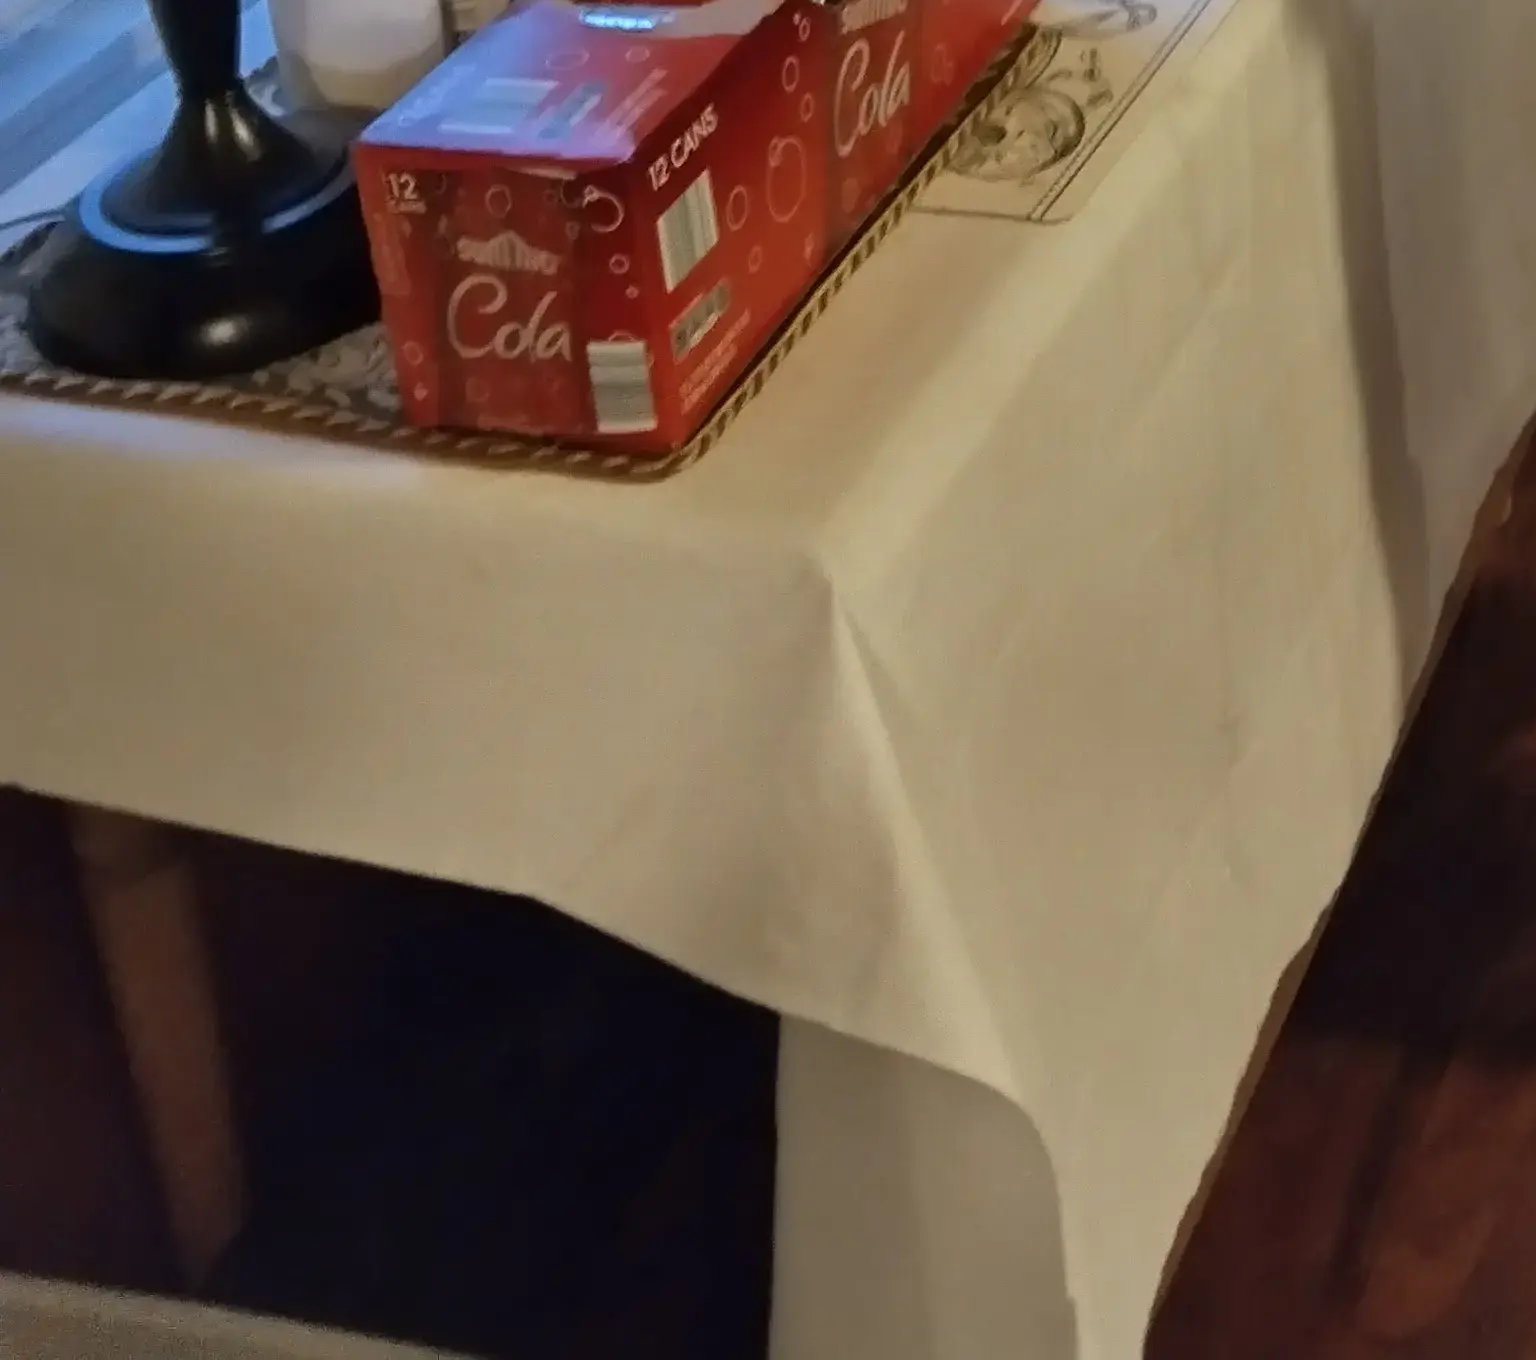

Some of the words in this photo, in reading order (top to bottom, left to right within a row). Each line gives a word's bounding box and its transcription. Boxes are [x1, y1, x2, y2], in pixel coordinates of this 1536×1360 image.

[834, 30, 911, 159] Cola
[386, 173, 416, 200] 12
[648, 152, 671, 191] 12
[670, 103, 718, 169] CANS
[447, 273, 572, 363] Cola
